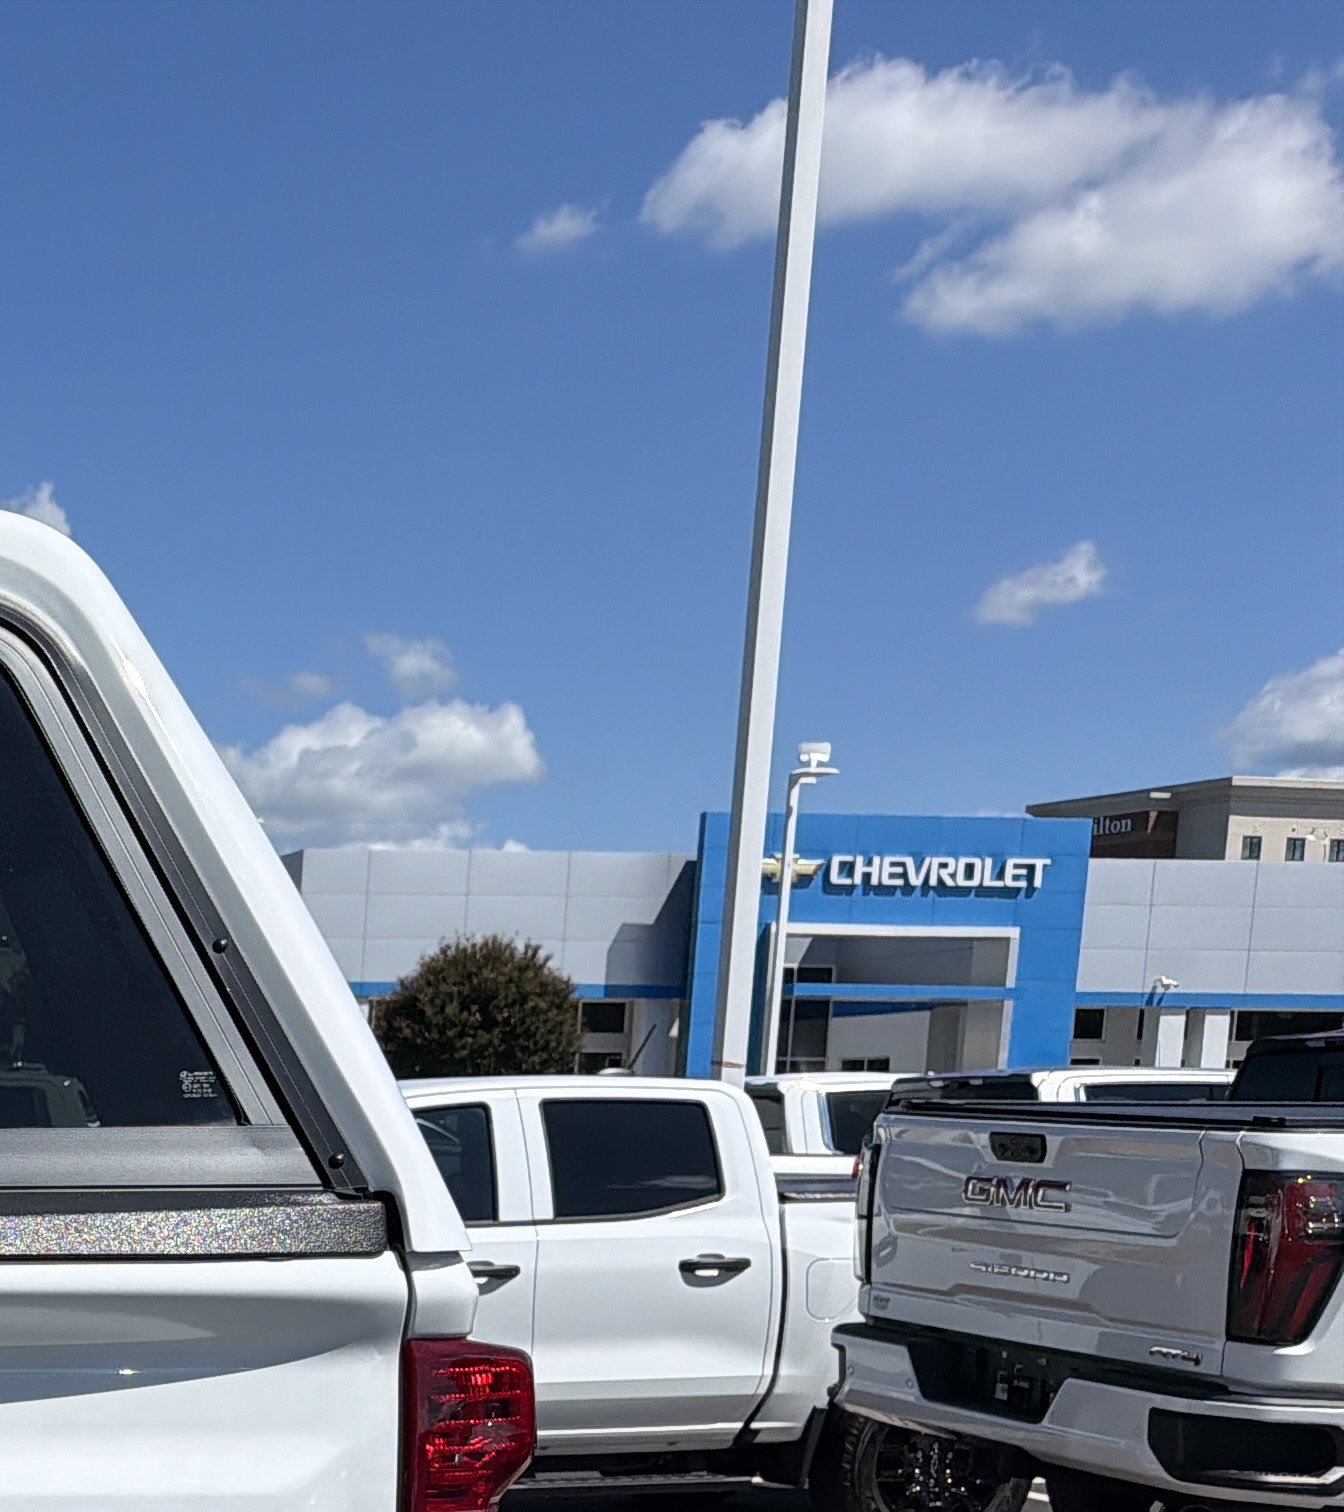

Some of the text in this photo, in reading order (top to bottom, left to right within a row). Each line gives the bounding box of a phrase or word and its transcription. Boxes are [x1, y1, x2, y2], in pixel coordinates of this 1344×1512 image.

[1092, 816, 1132, 836] ilton
[829, 855, 1051, 889] CHEVROLET
[962, 1175, 1072, 1213] GMC
